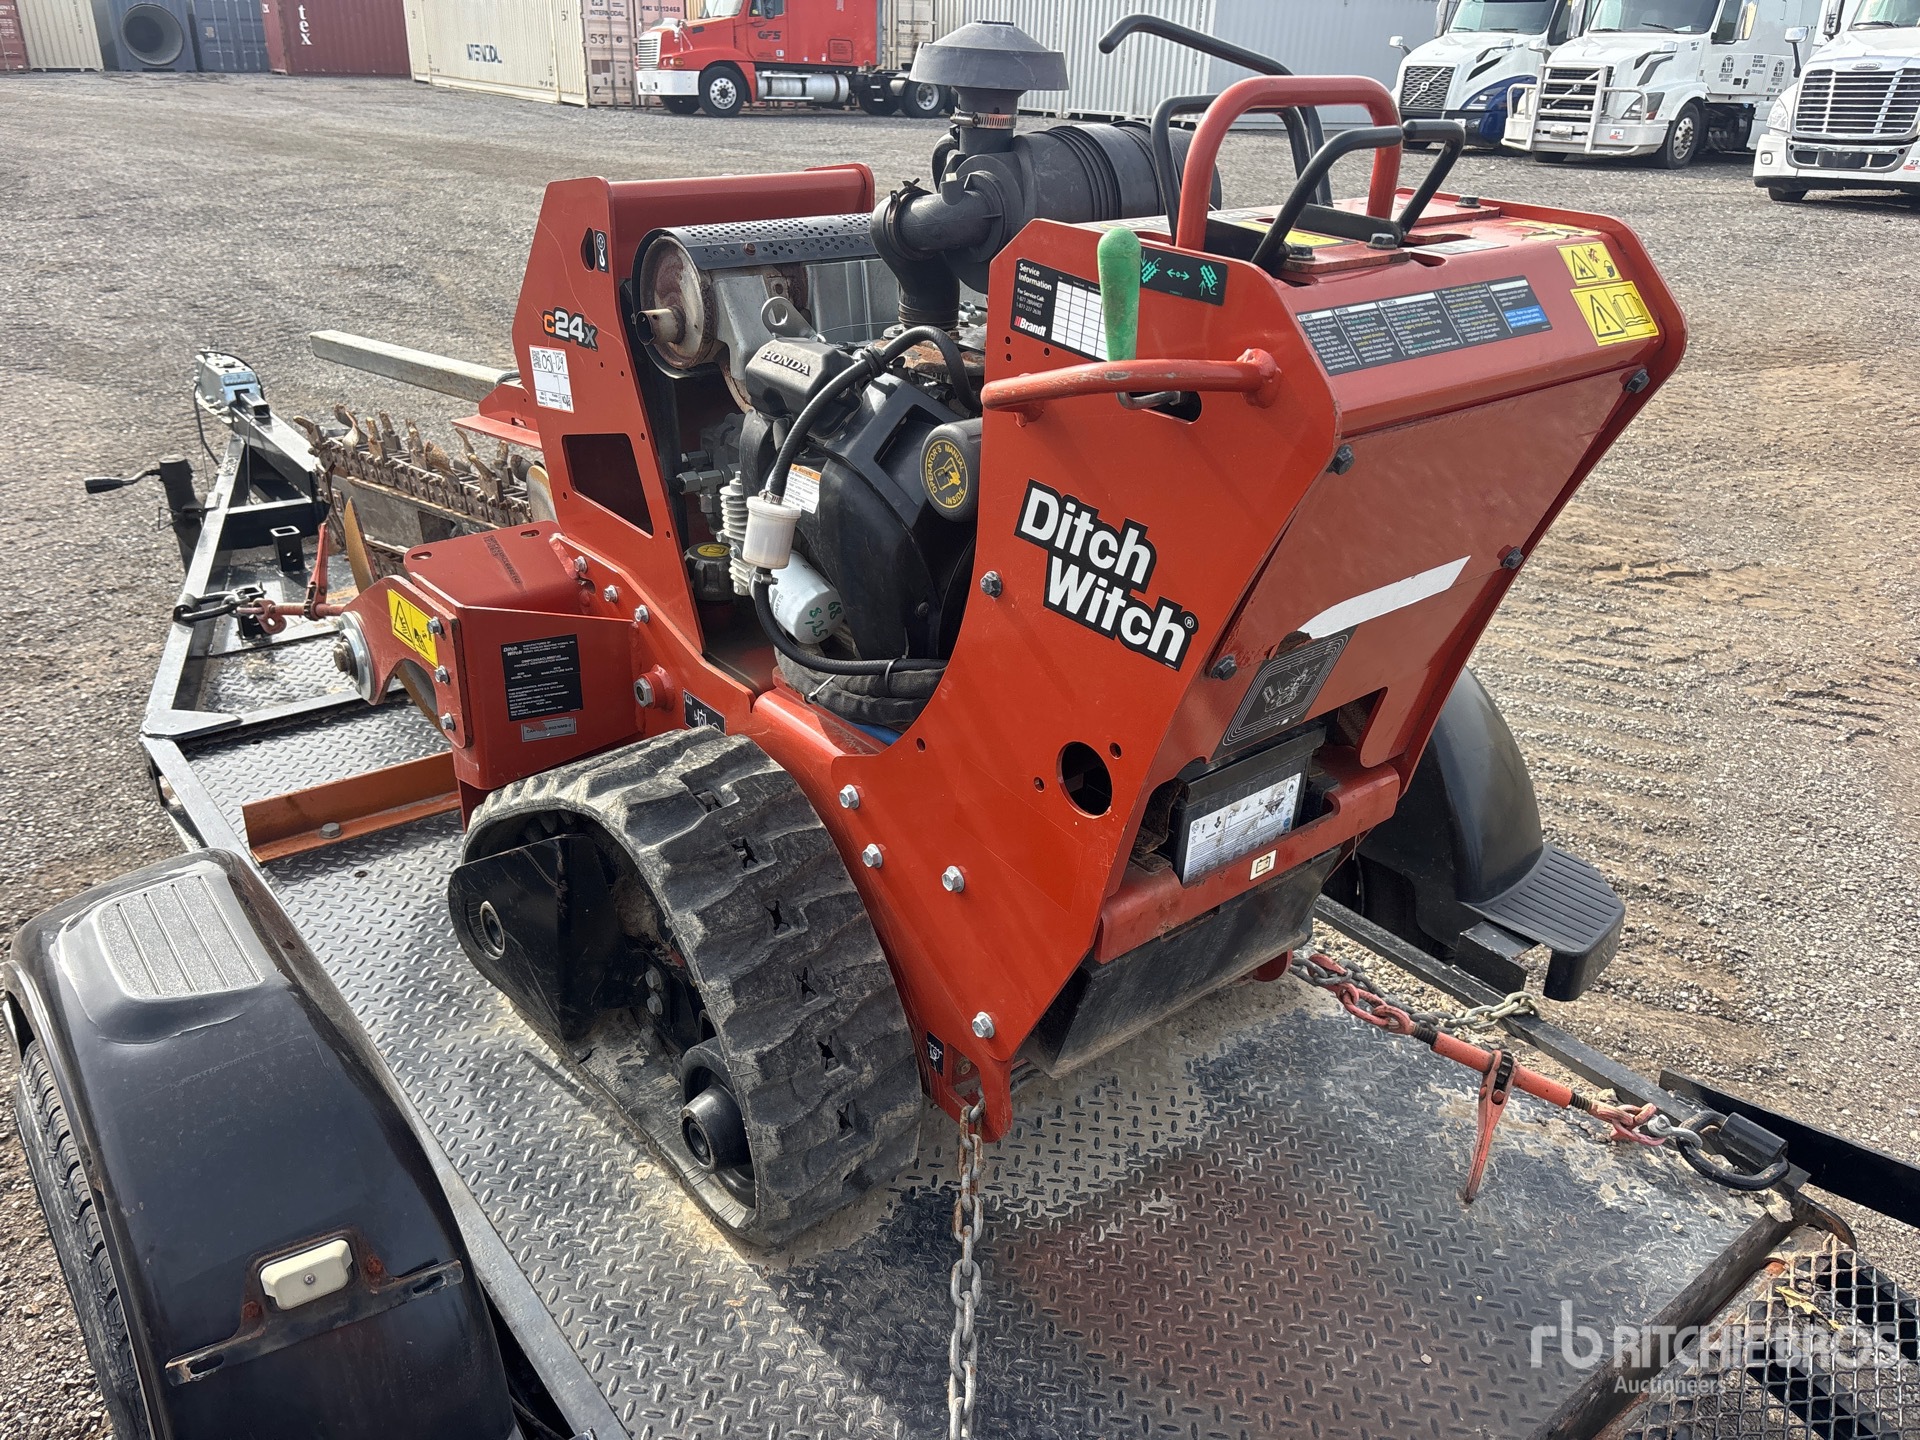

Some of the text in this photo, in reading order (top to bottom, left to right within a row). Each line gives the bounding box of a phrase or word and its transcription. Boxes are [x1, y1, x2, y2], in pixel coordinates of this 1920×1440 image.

[298, 4, 312, 45] tex
[758, 30, 781, 40] GFS
[1020, 262, 1040, 277] Service
[1018, 272, 1052, 292] Information
[1020, 317, 1046, 337] Brandt
[761, 350, 810, 376] HONDA
[928, 444, 964, 493] OPERATOR'S MANUAL
[946, 487, 965, 504] INSIDE
[1020, 487, 1151, 585] Ditch
